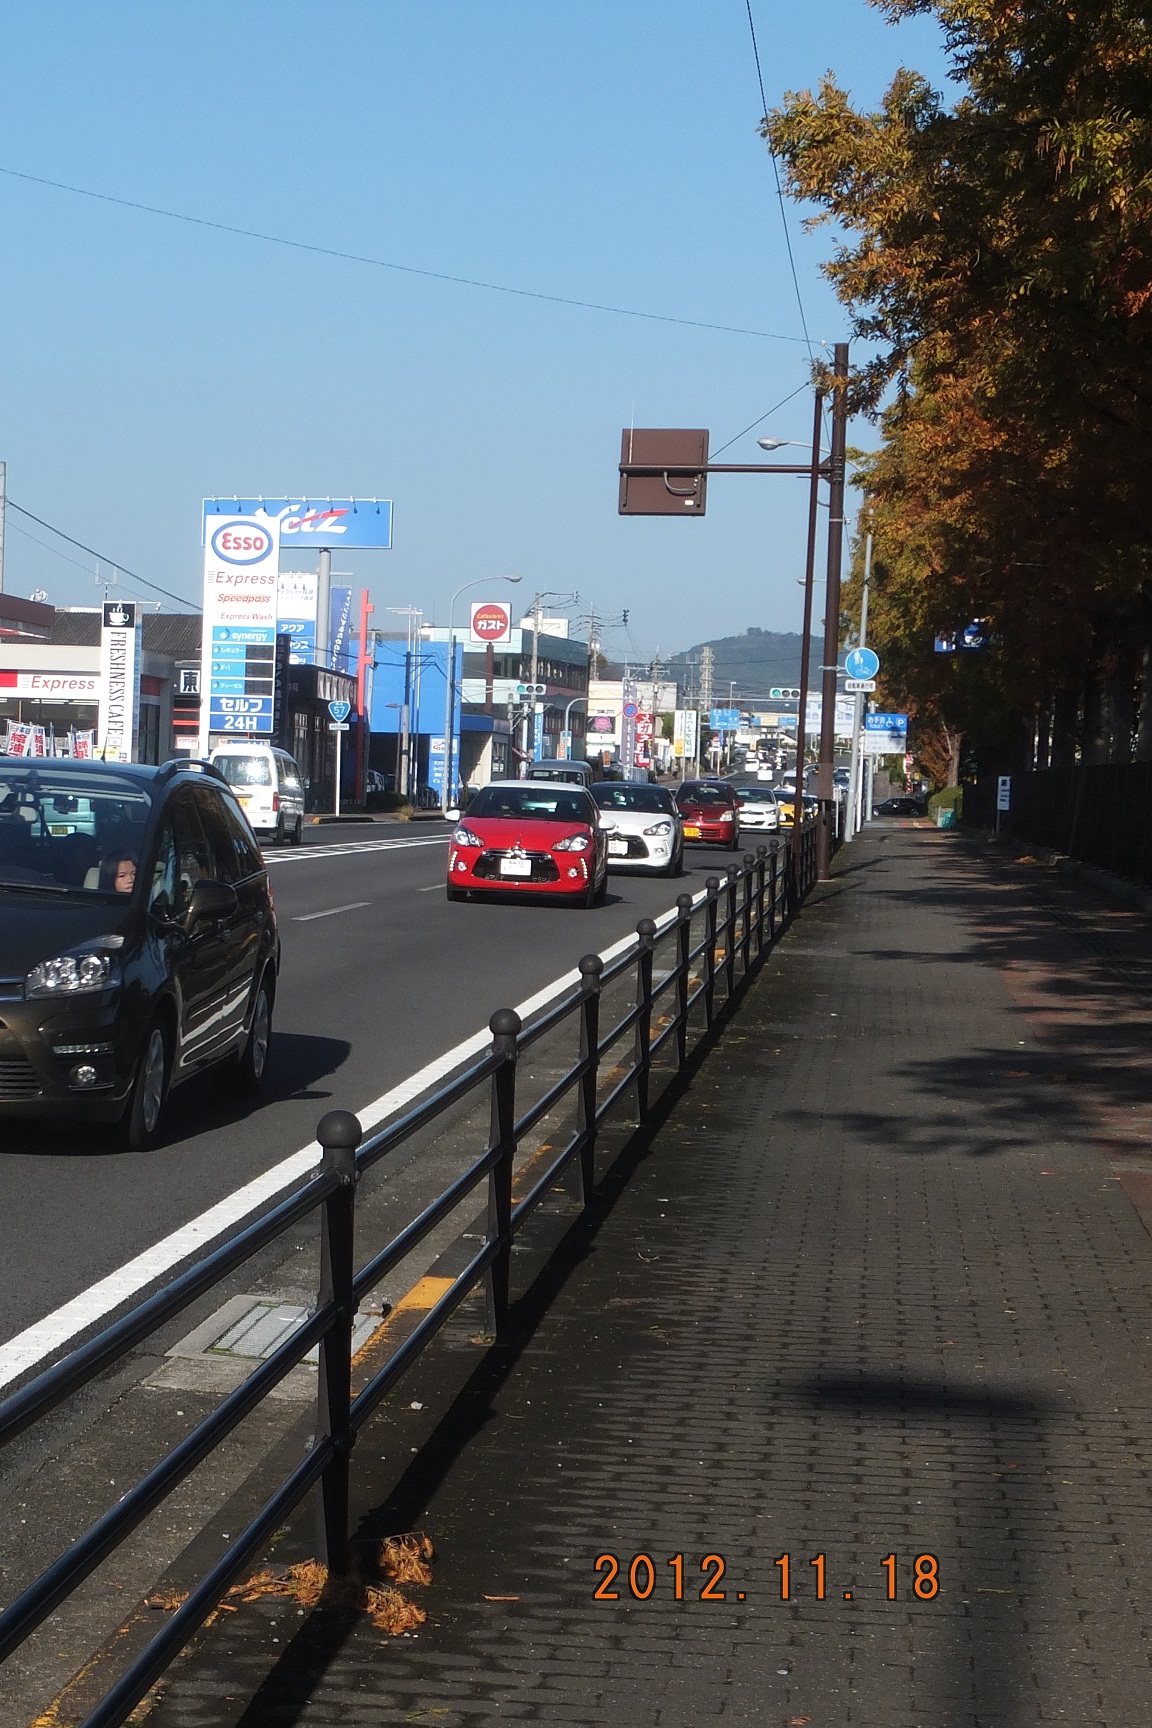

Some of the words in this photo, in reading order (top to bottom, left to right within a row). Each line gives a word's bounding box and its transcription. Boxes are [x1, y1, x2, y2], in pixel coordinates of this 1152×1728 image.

[215, 571, 275, 586] Express
[217, 593, 271, 603] Speedpass
[220, 612, 250, 620] Express
[280, 624, 305, 633] アクア
[477, 619, 506, 631] ガスト
[108, 631, 127, 702] FRESHNESS
[31, 676, 95, 692] Express
[220, 698, 263, 712] セルフ
[333, 706, 345, 714] 57
[108, 703, 124, 735] CAFE
[224, 716, 257, 730] 24H
